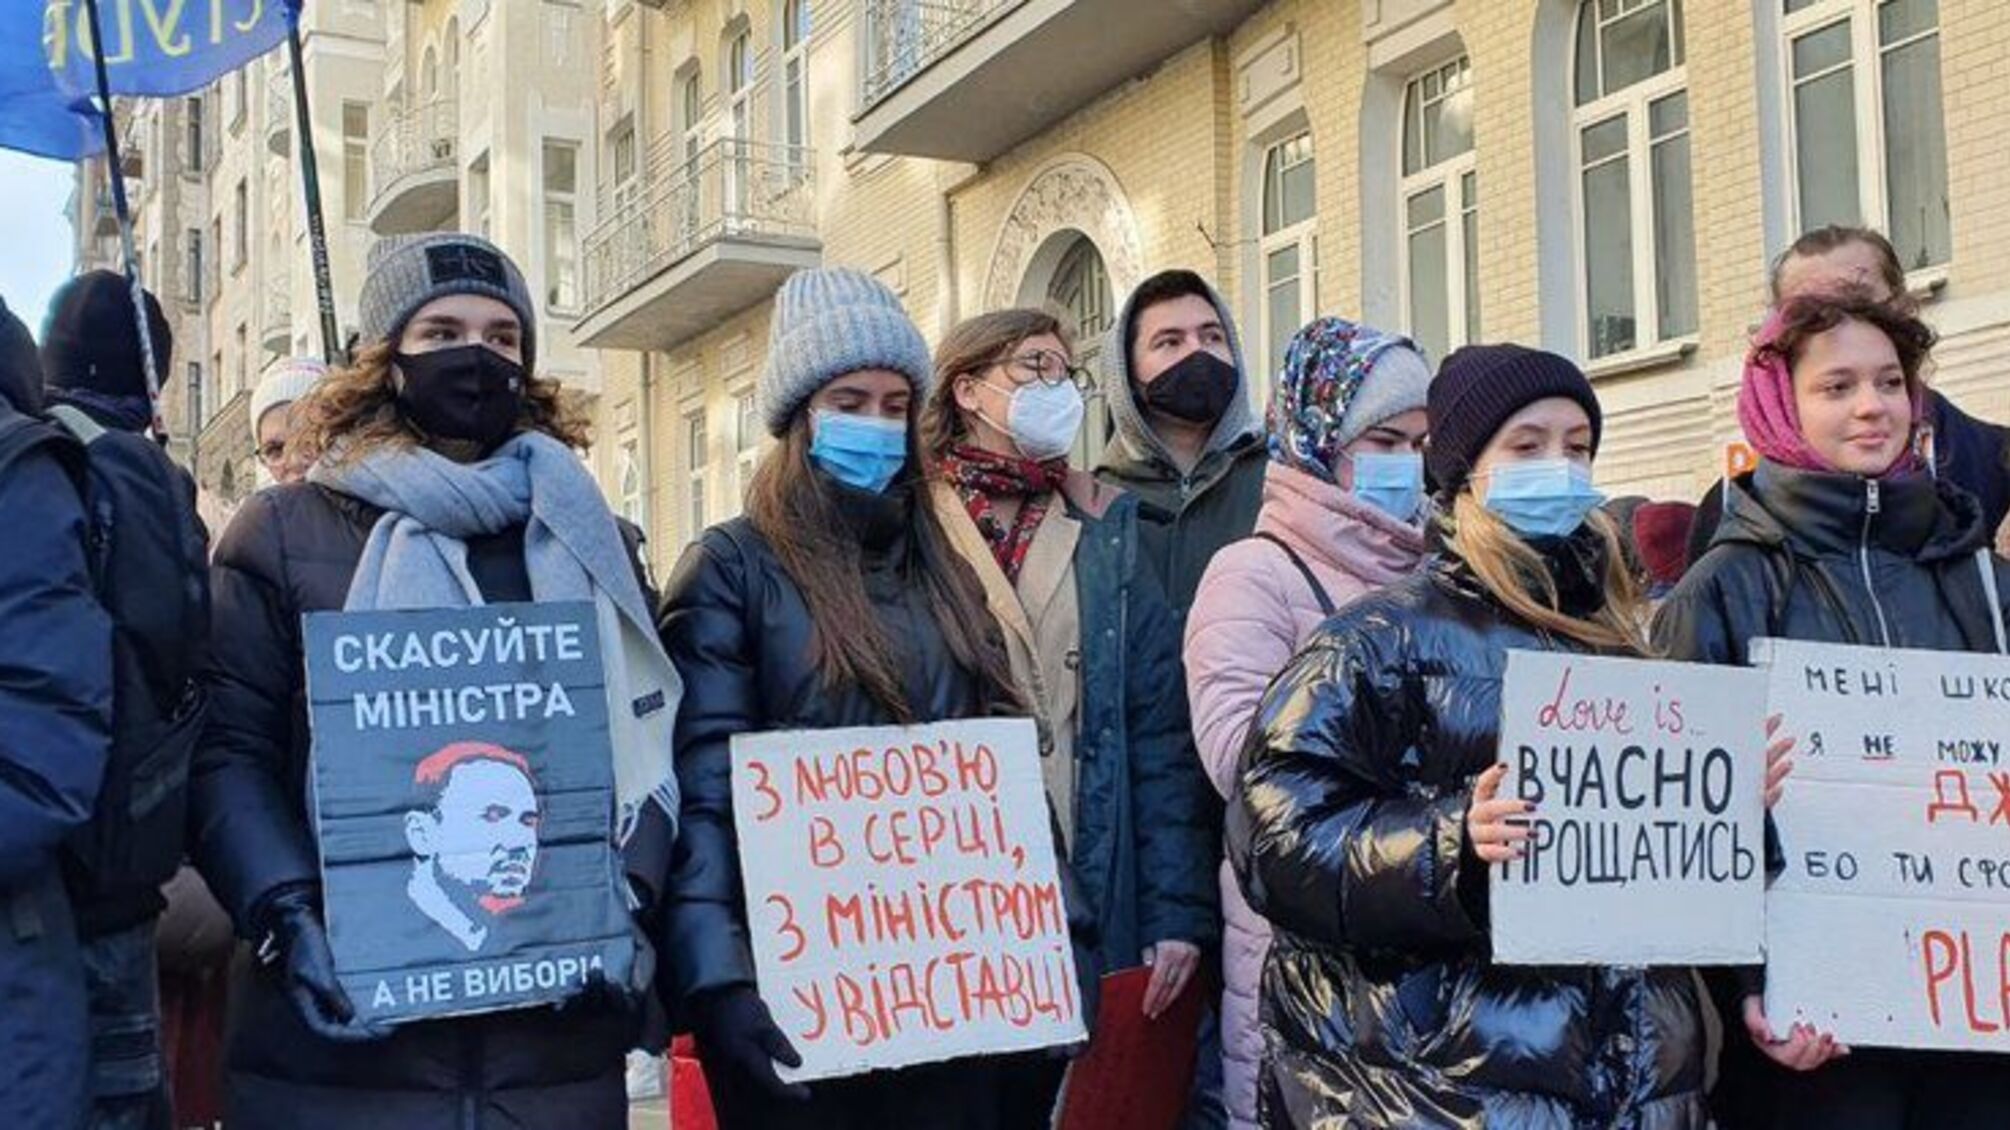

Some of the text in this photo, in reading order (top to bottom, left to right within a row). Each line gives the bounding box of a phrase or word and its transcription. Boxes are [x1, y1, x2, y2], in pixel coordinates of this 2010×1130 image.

[333, 617, 584, 674] СКАСУЙТЕ
[354, 682, 576, 731] МІНІСТРА
[1539, 666, 1634, 735] Love
[1808, 730, 2001, 767] Я НЕ МОЖУ
[747, 760, 783, 821] З
[1517, 745, 1735, 815] ВЧАСНО
[809, 815, 846, 867] В
[1804, 851, 1859, 882] БО
[1892, 851, 1935, 885] ТИ
[766, 894, 807, 962] З
[371, 979, 397, 1010] А
[406, 971, 454, 1005] НЕ
